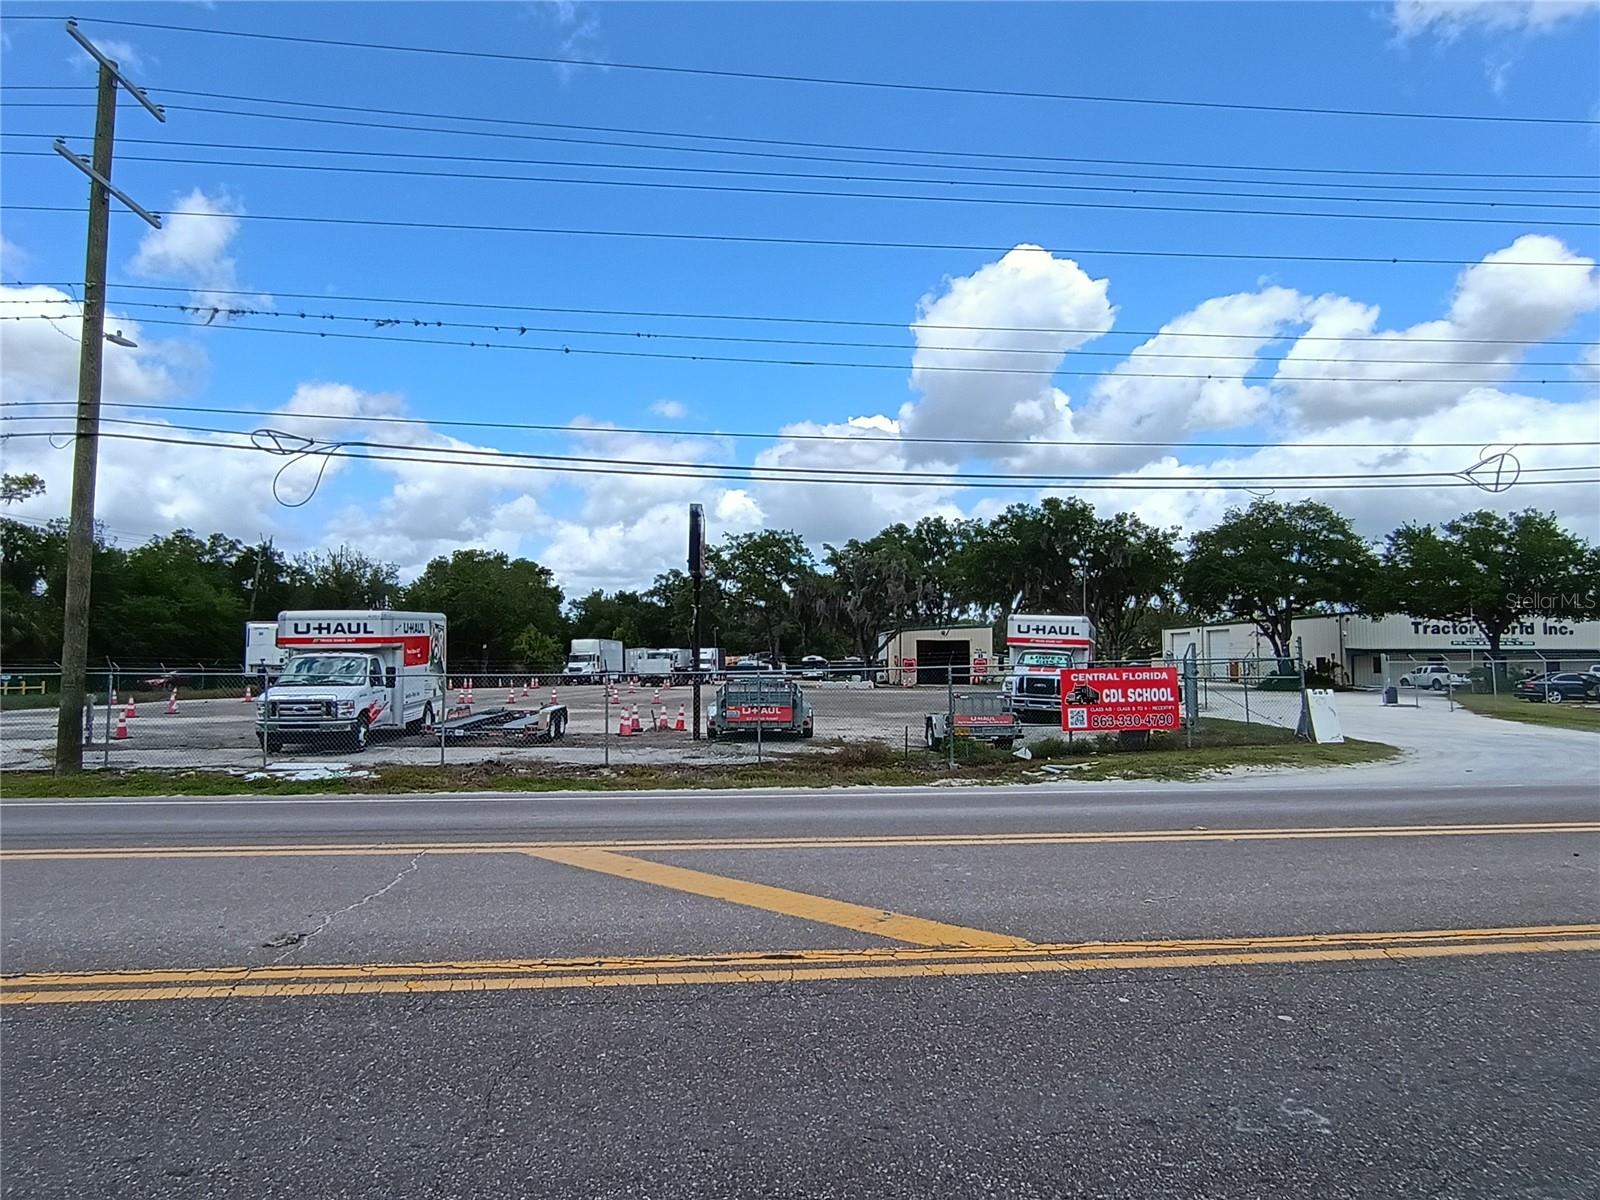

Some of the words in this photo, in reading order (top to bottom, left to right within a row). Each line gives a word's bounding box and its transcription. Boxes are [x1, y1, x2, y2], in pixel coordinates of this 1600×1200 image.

[294, 622, 374, 635] U-HAUL
[403, 622, 425, 634] U-HAUL
[1017, 624, 1080, 636] U-HAUL
[1411, 621, 1476, 635] Tractor
[1501, 622, 1535, 635] orld
[1543, 622, 1574, 635] Inc.
[1070, 672, 1119, 681] CENTRAL
[1122, 671, 1168, 680] FLORIDA
[1102, 688, 1125, 703] CDL
[1127, 687, 1174, 702] SCHOOL
[1092, 713, 1174, 728] 863-330-4790
